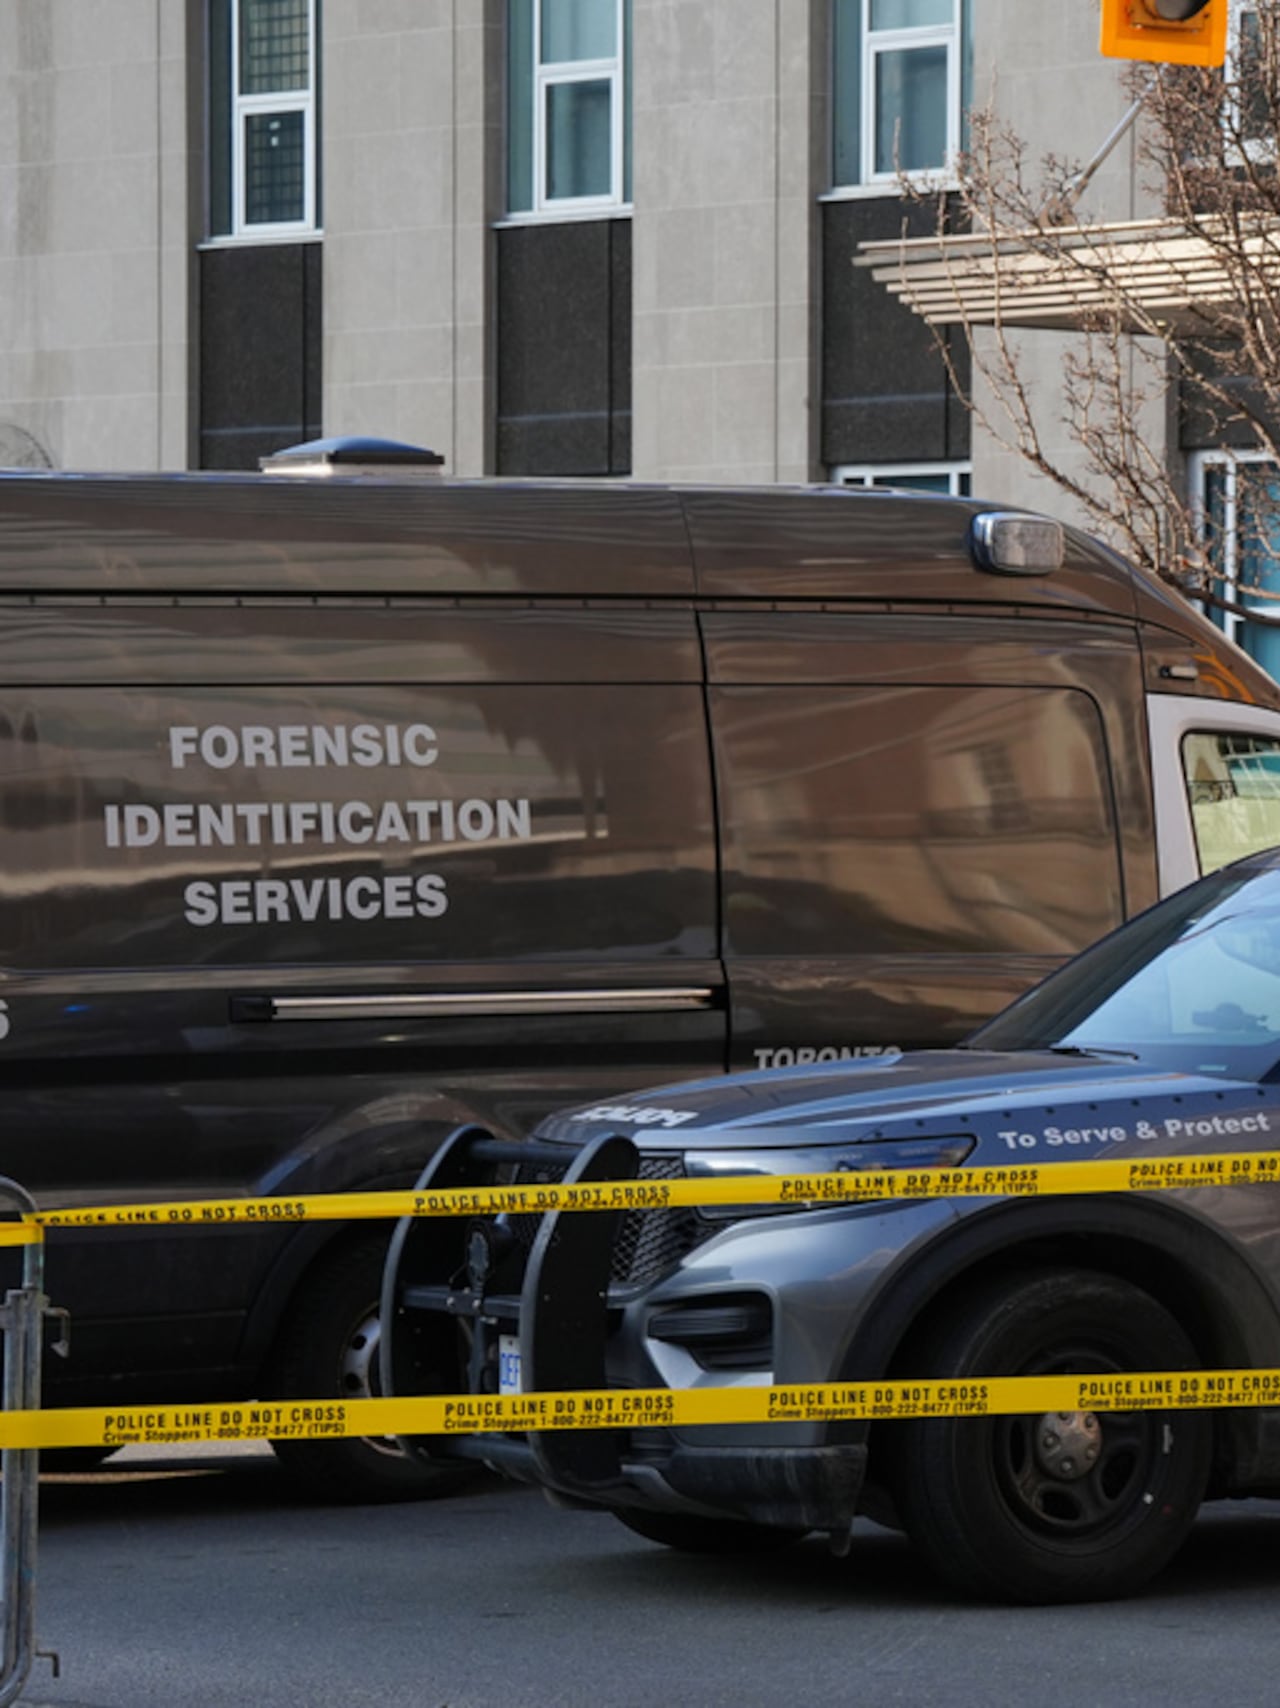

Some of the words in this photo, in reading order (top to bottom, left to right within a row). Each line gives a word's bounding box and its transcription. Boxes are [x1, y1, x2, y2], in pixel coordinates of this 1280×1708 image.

[169, 724, 439, 769] FORENSIC
[104, 799, 532, 847] IDENTIFICATION
[184, 874, 449, 926] SERVICES
[998, 1131, 1036, 1150] To
[1044, 1126, 1127, 1146] Serve
[1136, 1120, 1158, 1140] &
[1164, 1111, 1271, 1138] Protect
[1130, 1163, 1184, 1176] POLICE
[1191, 1161, 1224, 1174] LINE
[1232, 1159, 1250, 1172] DO
[782, 1177, 845, 1191] POLICE
[854, 1175, 895, 1189] LINE
[907, 1174, 929, 1187] DO
[940, 1172, 975, 1185] NOT
[984, 1170, 1039, 1183] CROSS
[414, 1195, 480, 1209] POLICE
[490, 1193, 527, 1206] LINE
[536, 1191, 559, 1204] DO
[568, 1189, 604, 1203] NOT
[612, 1186, 670, 1201] CROSS
[780, 1190, 816, 1201] Crime
[168, 1208, 192, 1220] DO
[202, 1206, 236, 1219] NOT
[246, 1202, 306, 1218] CROSS
[770, 1390, 824, 1406] POLICE
[832, 1389, 866, 1404] LINE
[875, 1388, 894, 1403] DO
[902, 1387, 930, 1402] NOT
[938, 1385, 988, 1401] CROSS
[1080, 1380, 1132, 1396] POLICE
[1140, 1379, 1173, 1394] LINE
[1180, 1378, 1200, 1393] DO
[1207, 1377, 1234, 1392] NOT
[444, 1400, 503, 1416] POLICE
[512, 1399, 548, 1414] LINE
[555, 1398, 575, 1413] DO
[584, 1397, 614, 1412] NOT
[622, 1395, 674, 1411] CROSS
[768, 1407, 801, 1418] Crime
[806, 1406, 856, 1417] Stoppers
[862, 1403, 950, 1416] 1-800-222-8477
[954, 1401, 988, 1413] (TIPS)
[1078, 1397, 1110, 1408] Crime
[104, 1413, 166, 1429] POLICE
[174, 1411, 212, 1427] LINE
[221, 1410, 242, 1425] DO
[250, 1409, 282, 1424] NOT
[291, 1406, 346, 1422] CROSS
[444, 1418, 478, 1430] Crime
[483, 1416, 535, 1429] Stoppers
[542, 1413, 634, 1427] 1-800-222-8477
[638, 1411, 673, 1424] (TIPS)
[103, 1429, 139, 1443] Crime
[145, 1427, 199, 1441] Stoppers
[206, 1424, 303, 1439] 1-800-222-8477
[308, 1422, 345, 1436] (TIPS)
